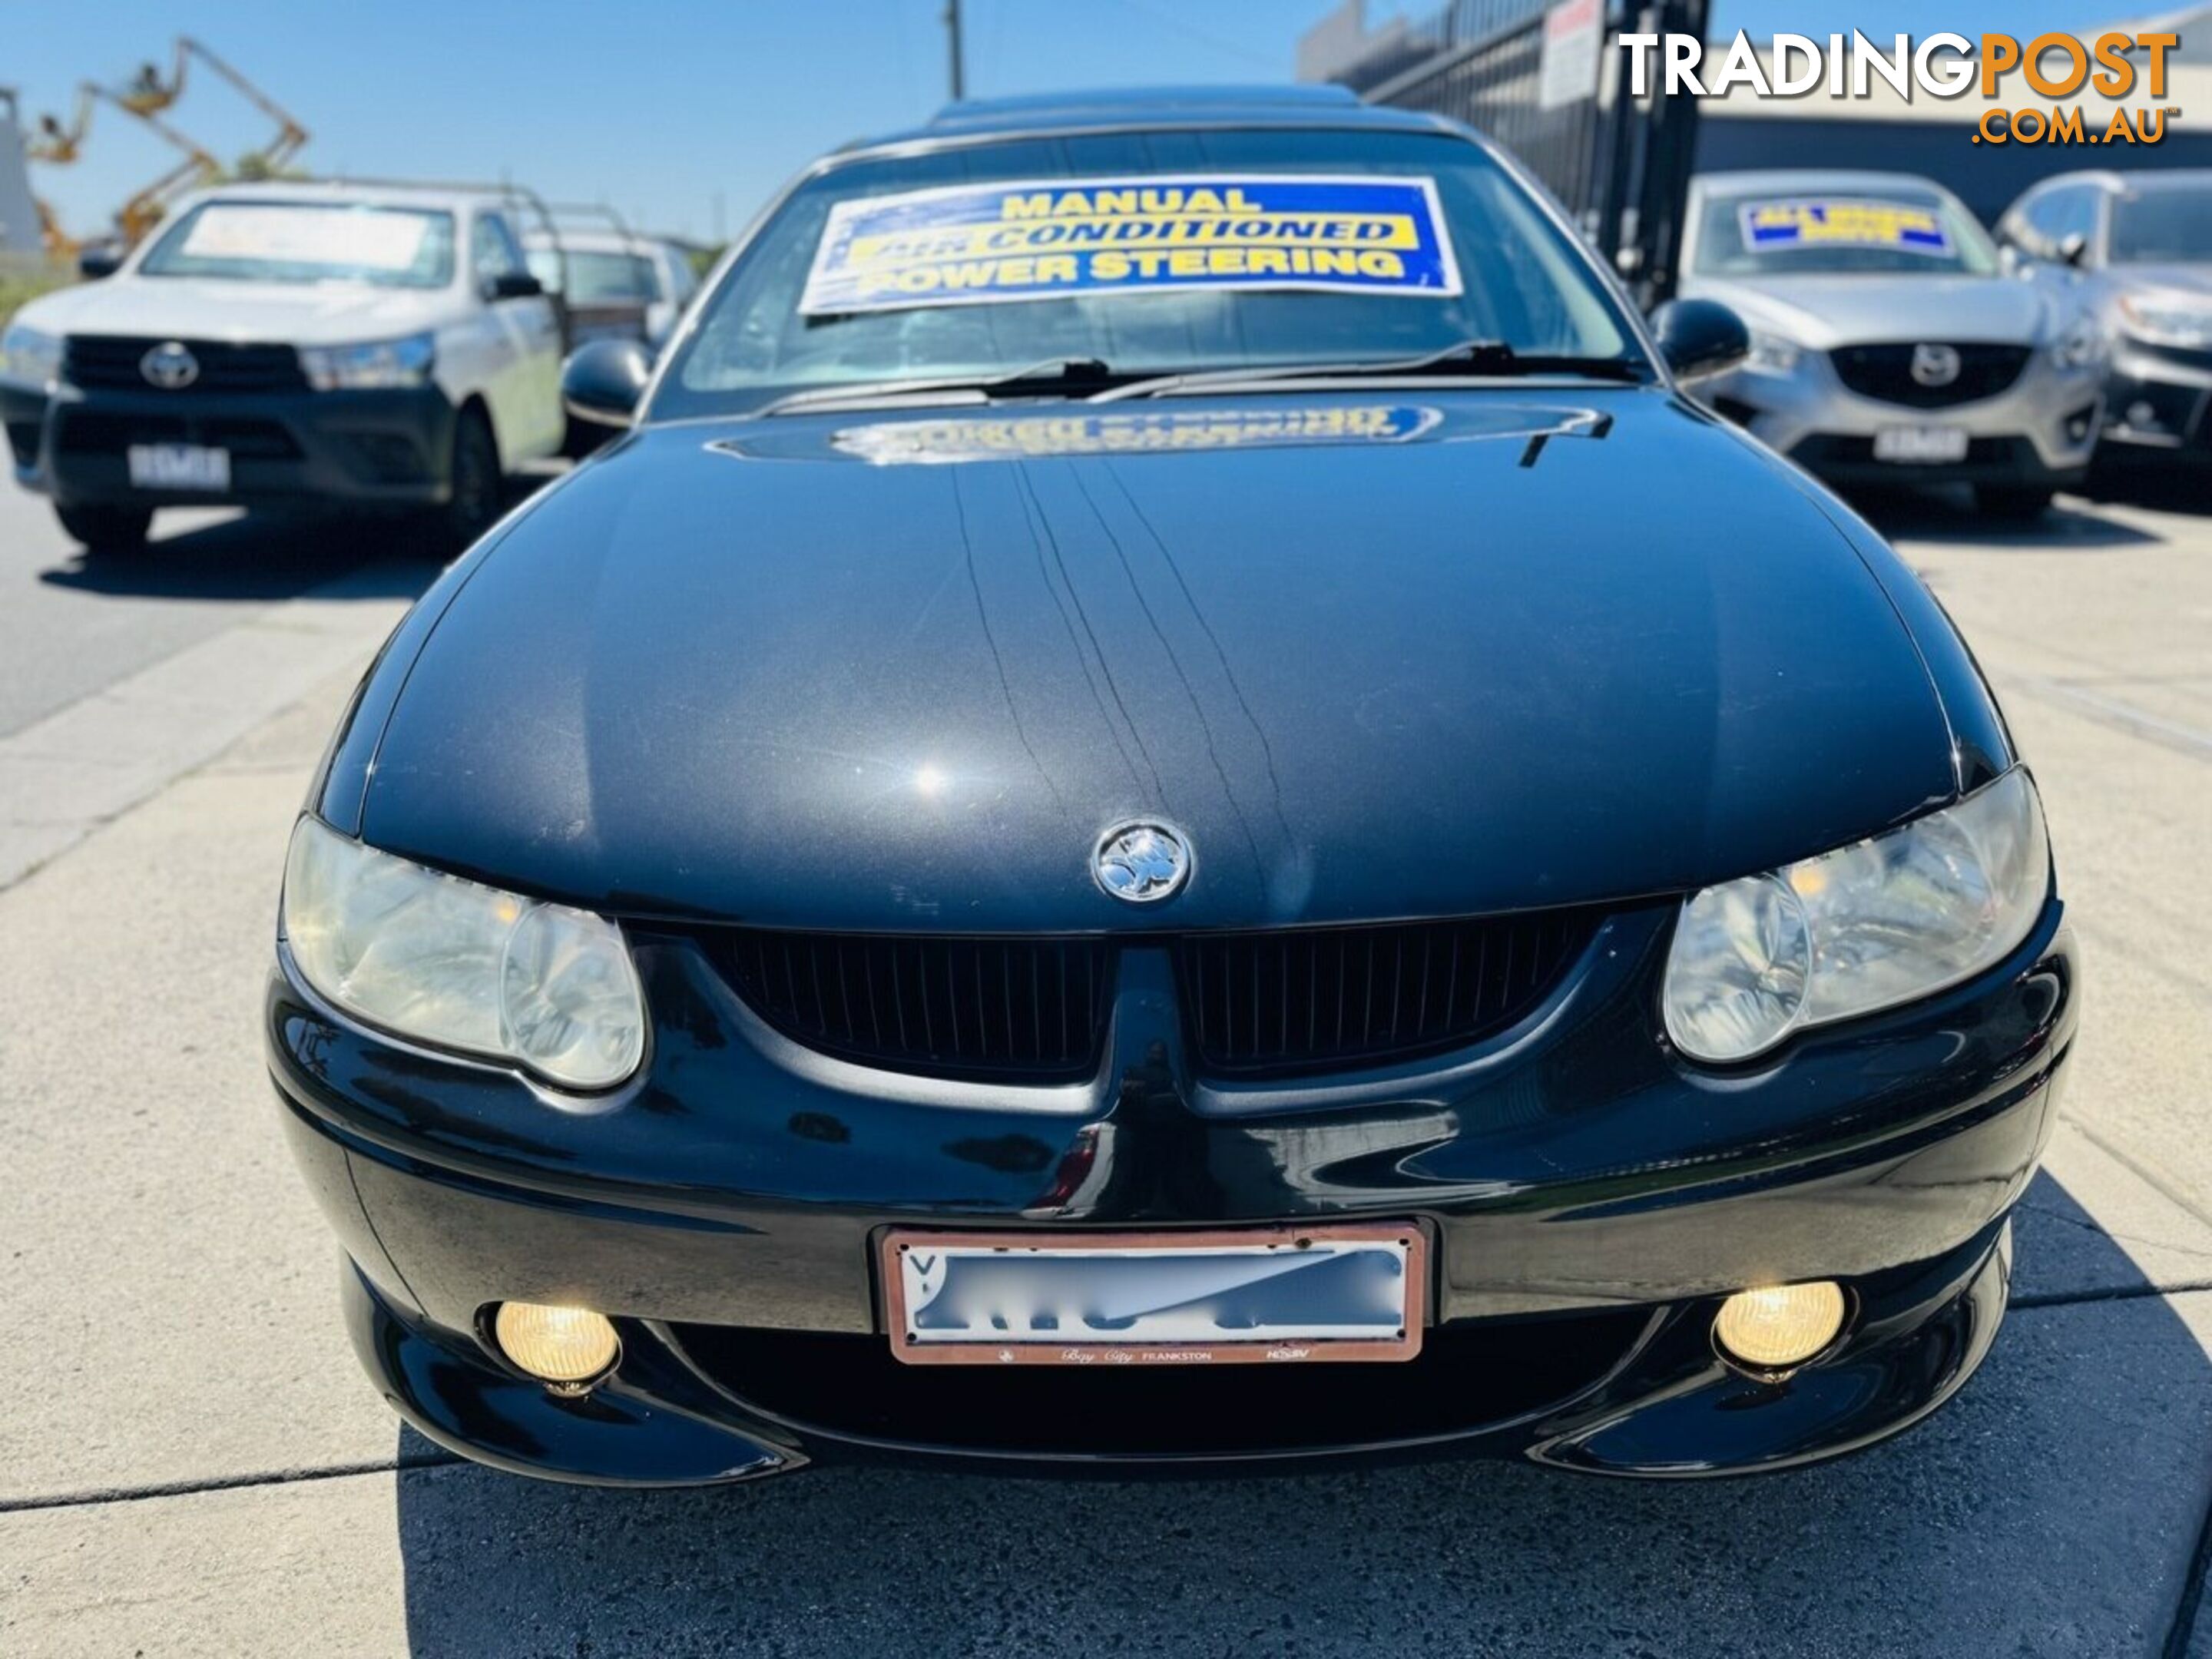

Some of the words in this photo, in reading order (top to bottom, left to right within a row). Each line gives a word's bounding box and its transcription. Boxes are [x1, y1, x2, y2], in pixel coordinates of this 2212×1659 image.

[1002, 189, 1262, 220] MANUAL
[874, 233, 970, 257] AIR
[983, 220, 1395, 249] CONDITIONED
[856, 254, 1078, 295] POWER
[1090, 249, 1406, 280] STEERING
[1104, 1349, 1133, 1364] City
[1141, 1351, 1212, 1361] FRANKSTON
